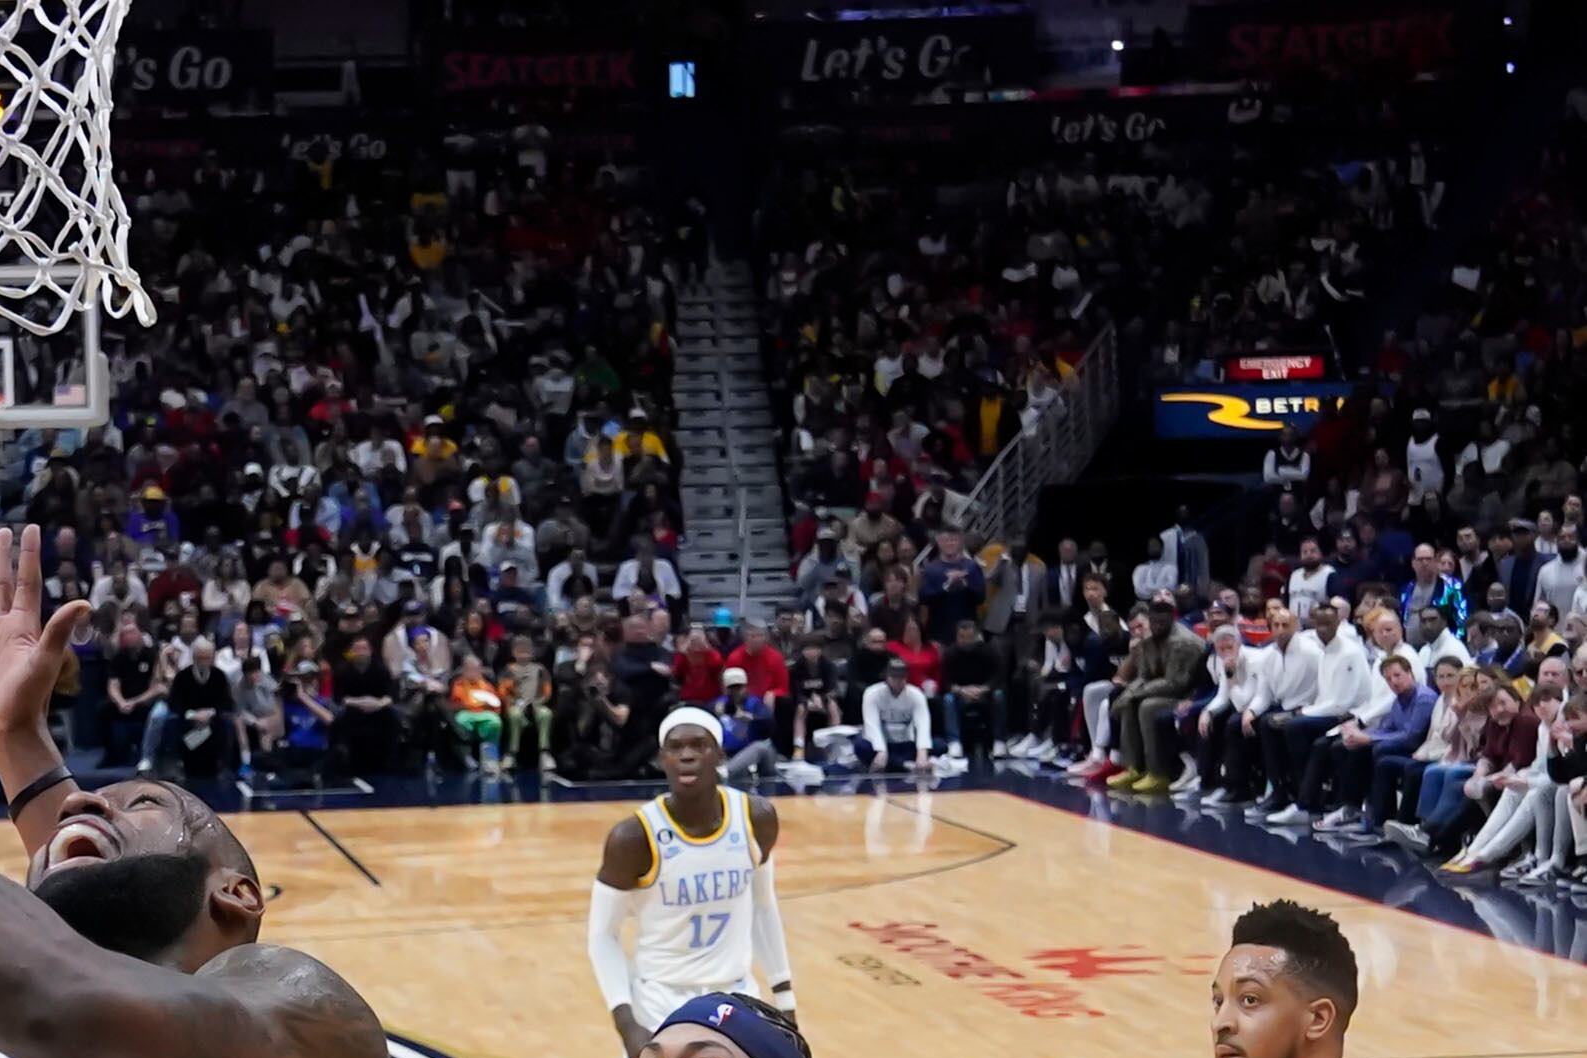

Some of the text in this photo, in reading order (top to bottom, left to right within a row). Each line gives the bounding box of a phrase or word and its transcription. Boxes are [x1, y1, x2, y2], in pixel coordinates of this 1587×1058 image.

[167, 45, 233, 90] Go
[800, 34, 905, 82] Let's
[1261, 367, 1288, 380] EXIT
[659, 867, 753, 907] LAKERS
[689, 912, 731, 949] 17
